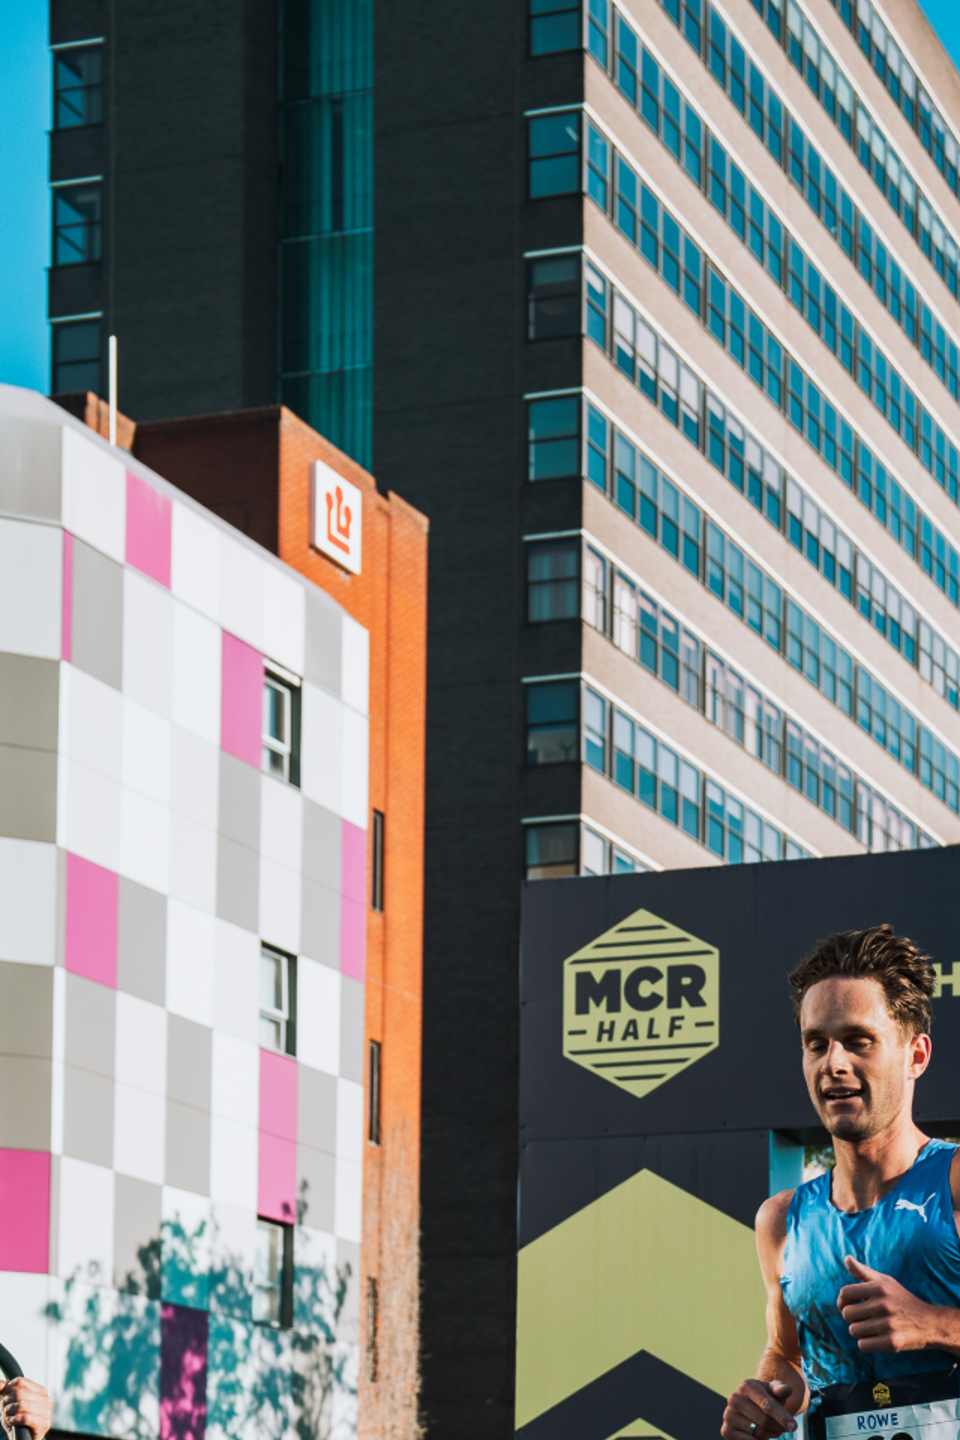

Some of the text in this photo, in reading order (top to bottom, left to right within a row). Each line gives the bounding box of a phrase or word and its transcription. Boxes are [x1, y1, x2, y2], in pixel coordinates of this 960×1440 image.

[575, 963, 707, 1015] MCR
[596, 1016, 684, 1043] HALF
[857, 1413, 900, 1430] ROWE
